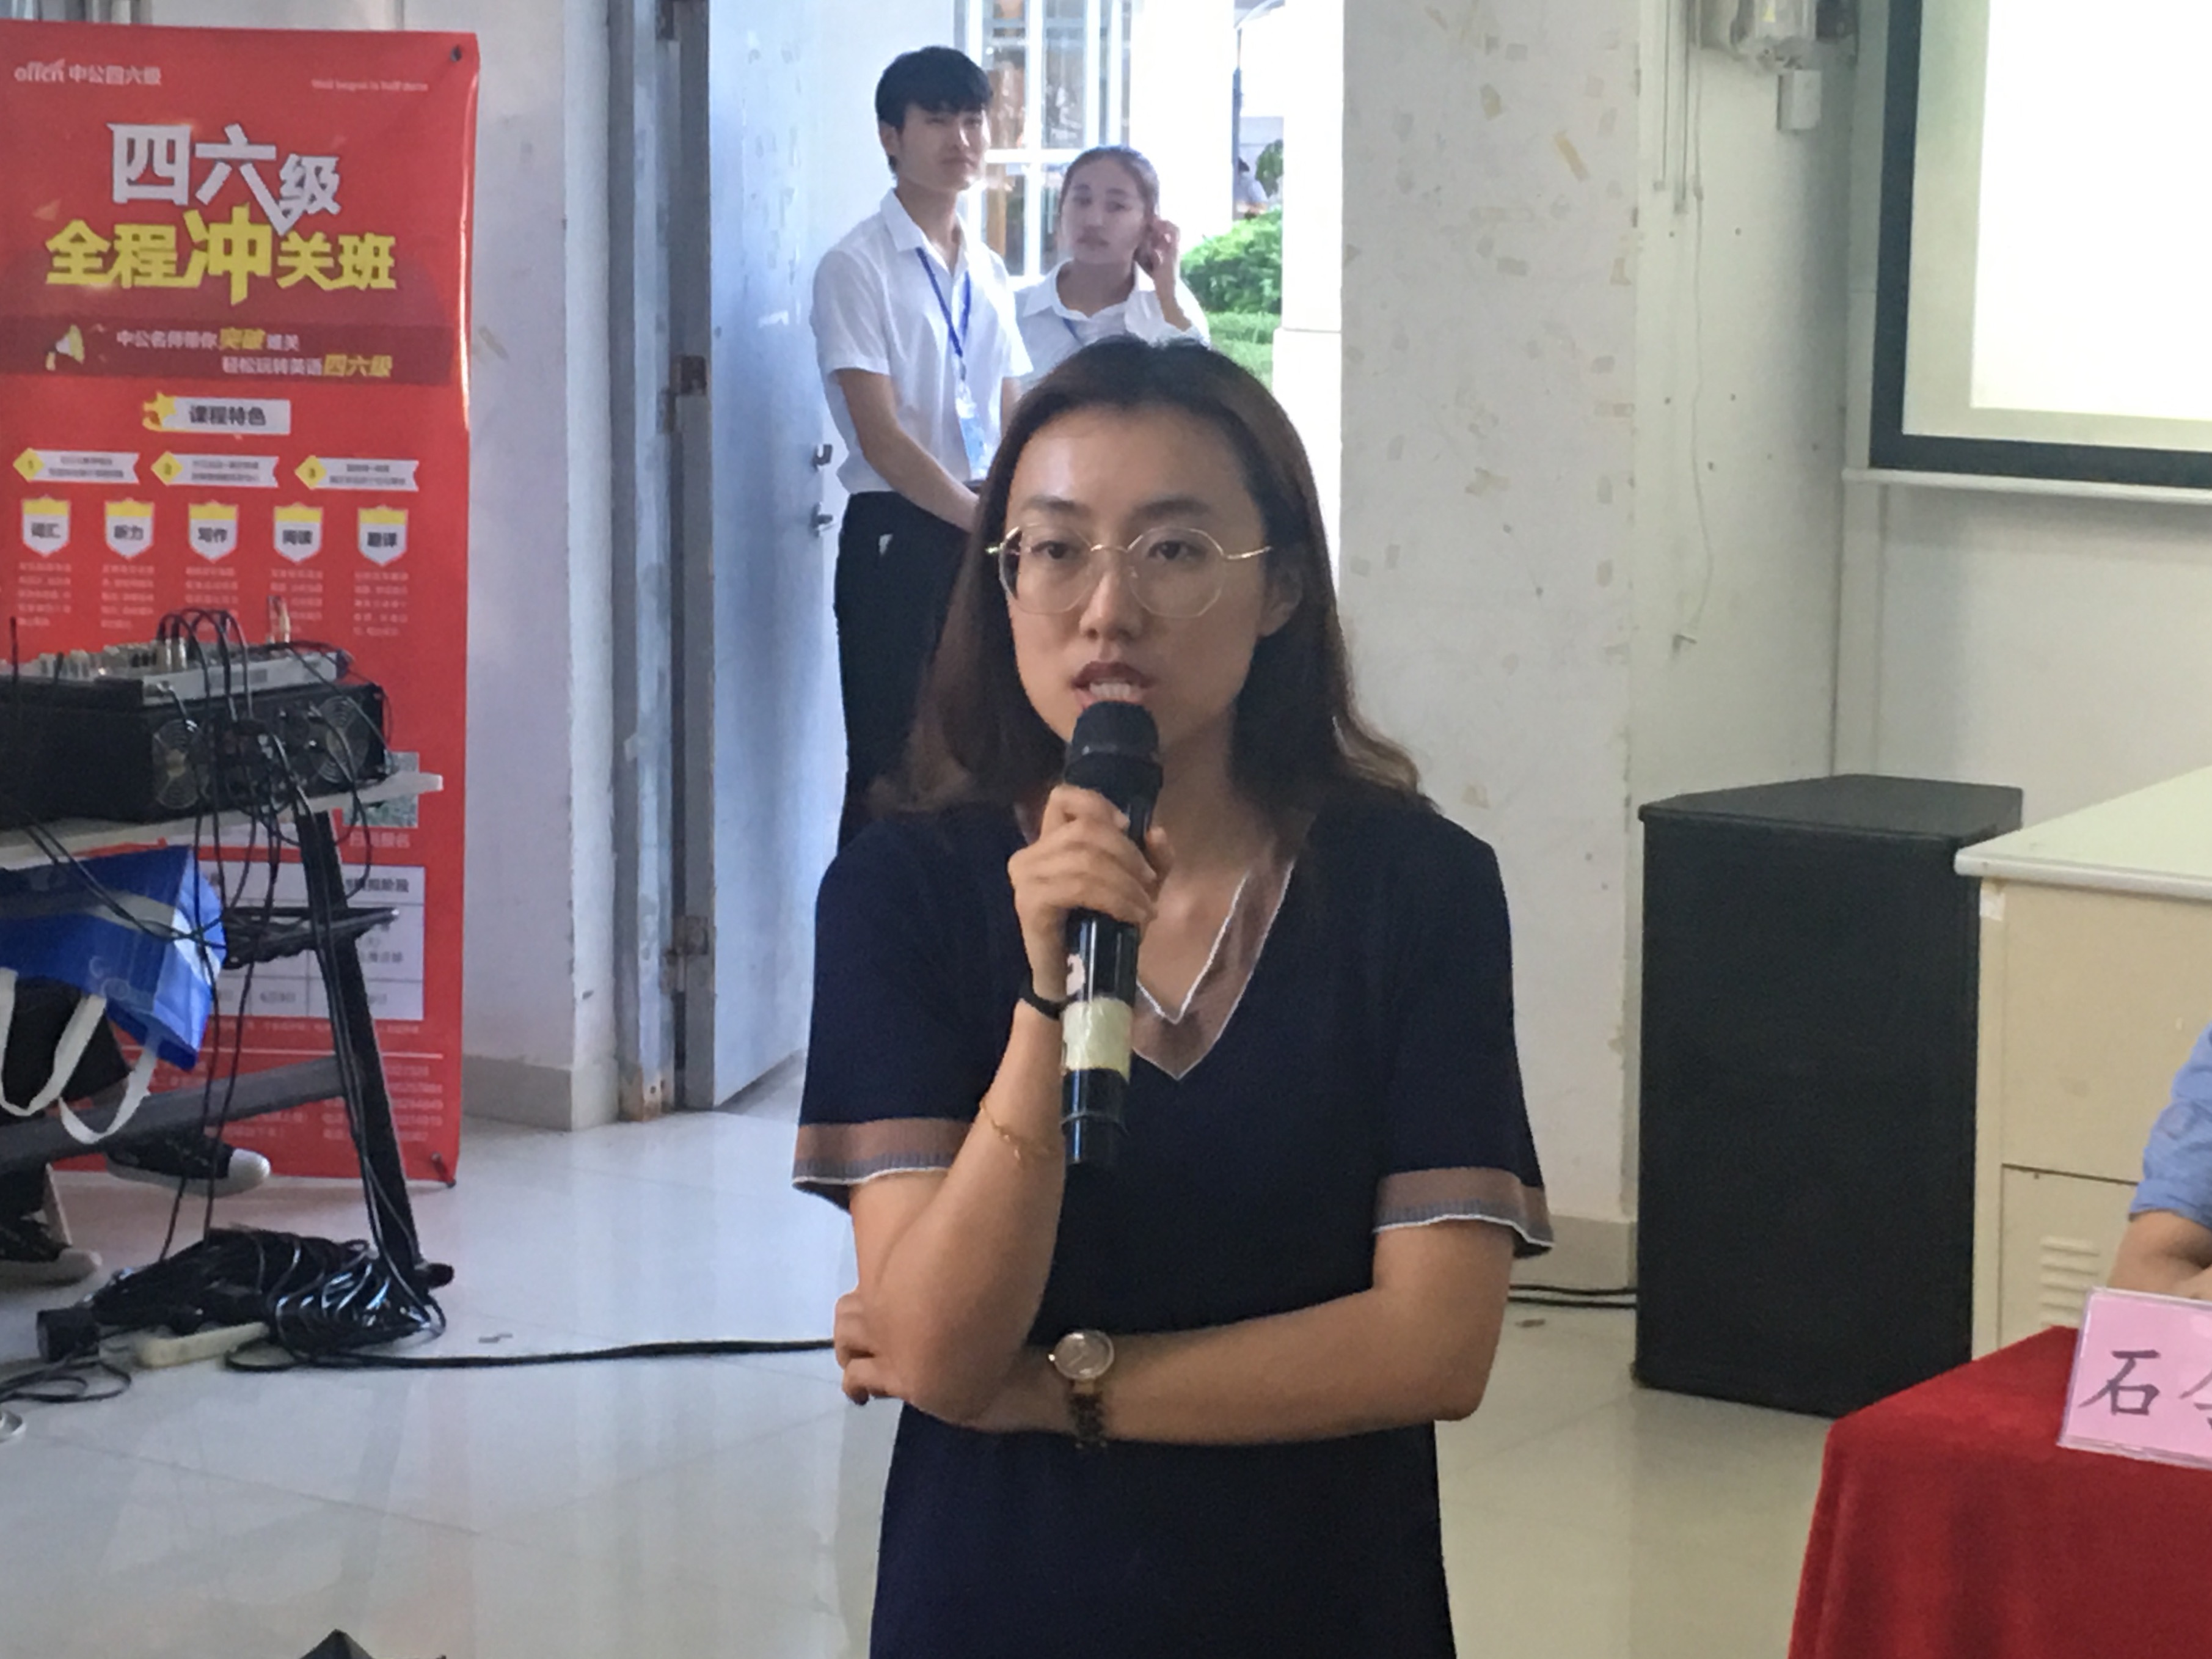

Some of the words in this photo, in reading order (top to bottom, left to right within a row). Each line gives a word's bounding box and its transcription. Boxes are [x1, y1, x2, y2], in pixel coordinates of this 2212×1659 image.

[106, 123, 340, 236] 四六级
[46, 202, 396, 306] 全程冲关班
[189, 405, 267, 427] 课程特色
[198, 527, 228, 543] 写作
